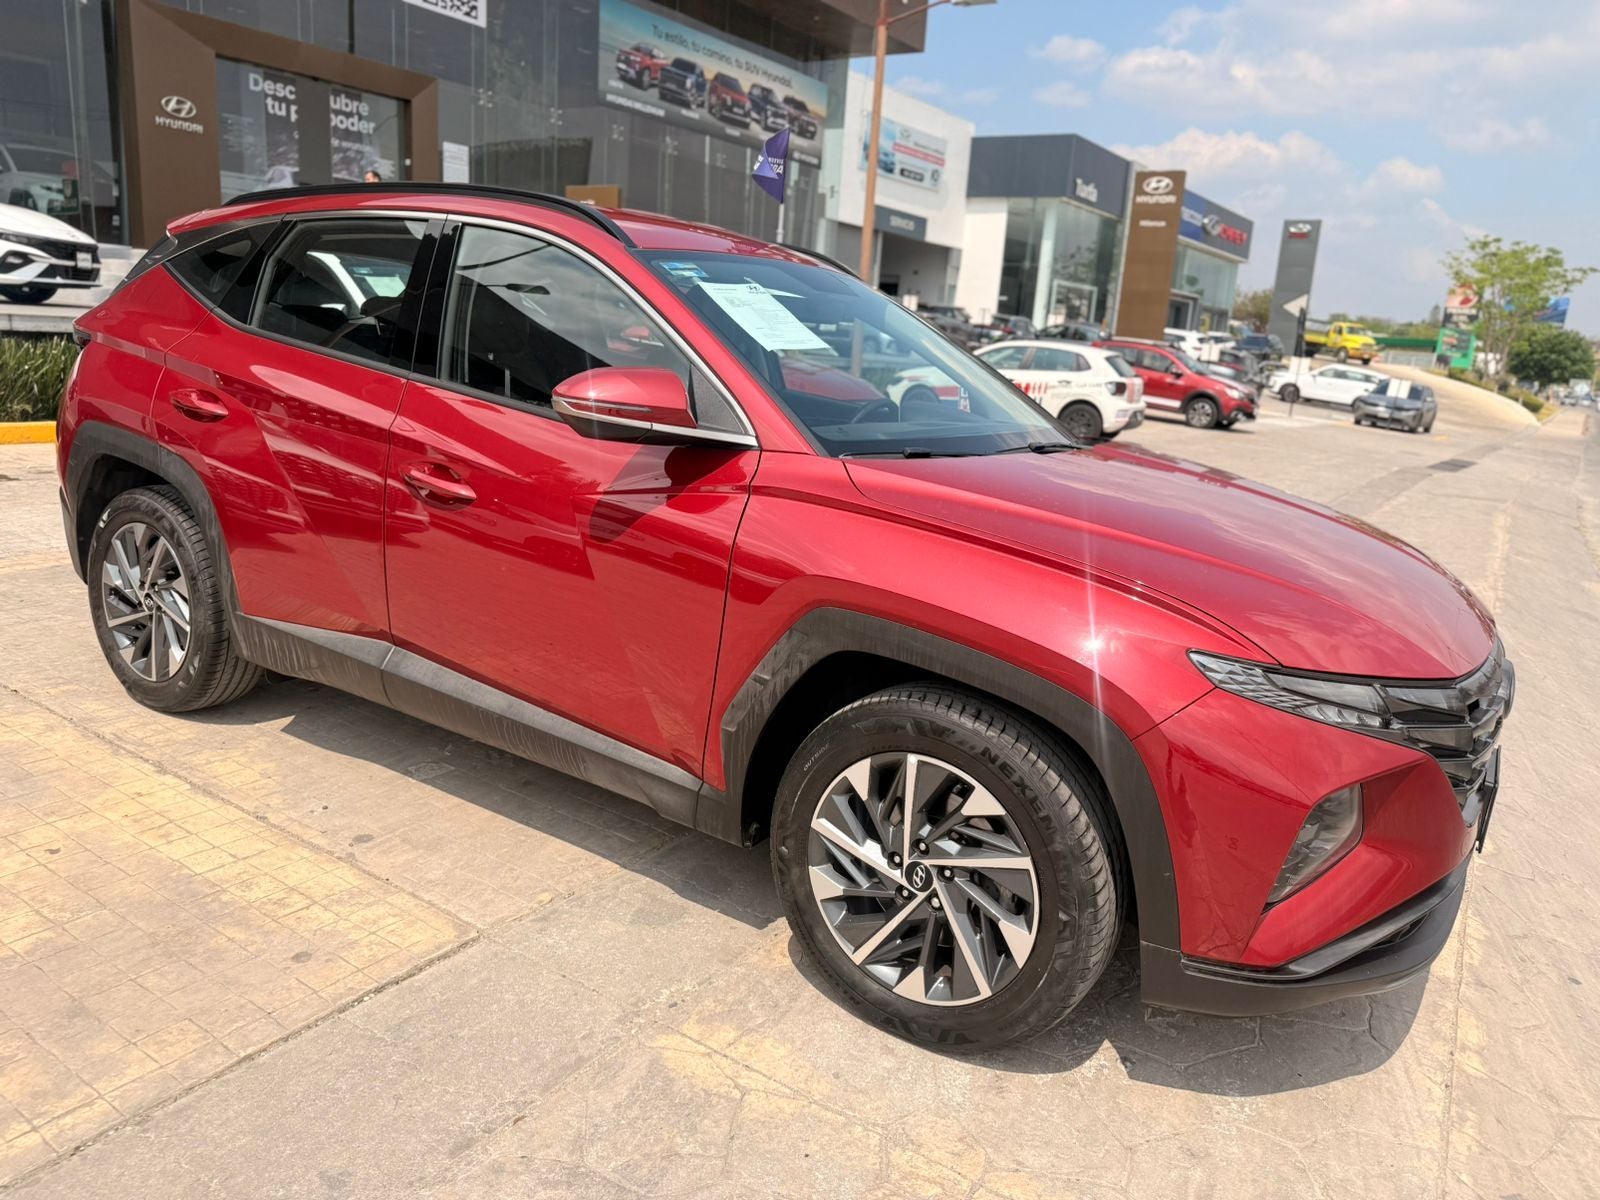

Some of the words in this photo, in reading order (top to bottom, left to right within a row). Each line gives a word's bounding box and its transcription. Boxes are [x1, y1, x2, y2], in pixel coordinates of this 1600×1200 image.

[652, 24, 663, 39] Tu
[691, 40, 701, 53] tu
[265, 97, 287, 117] tu
[155, 116, 204, 134] HYUNDAI
[1135, 194, 1177, 205] HYUNDAI
[980, 746, 1057, 834] NEXEN
